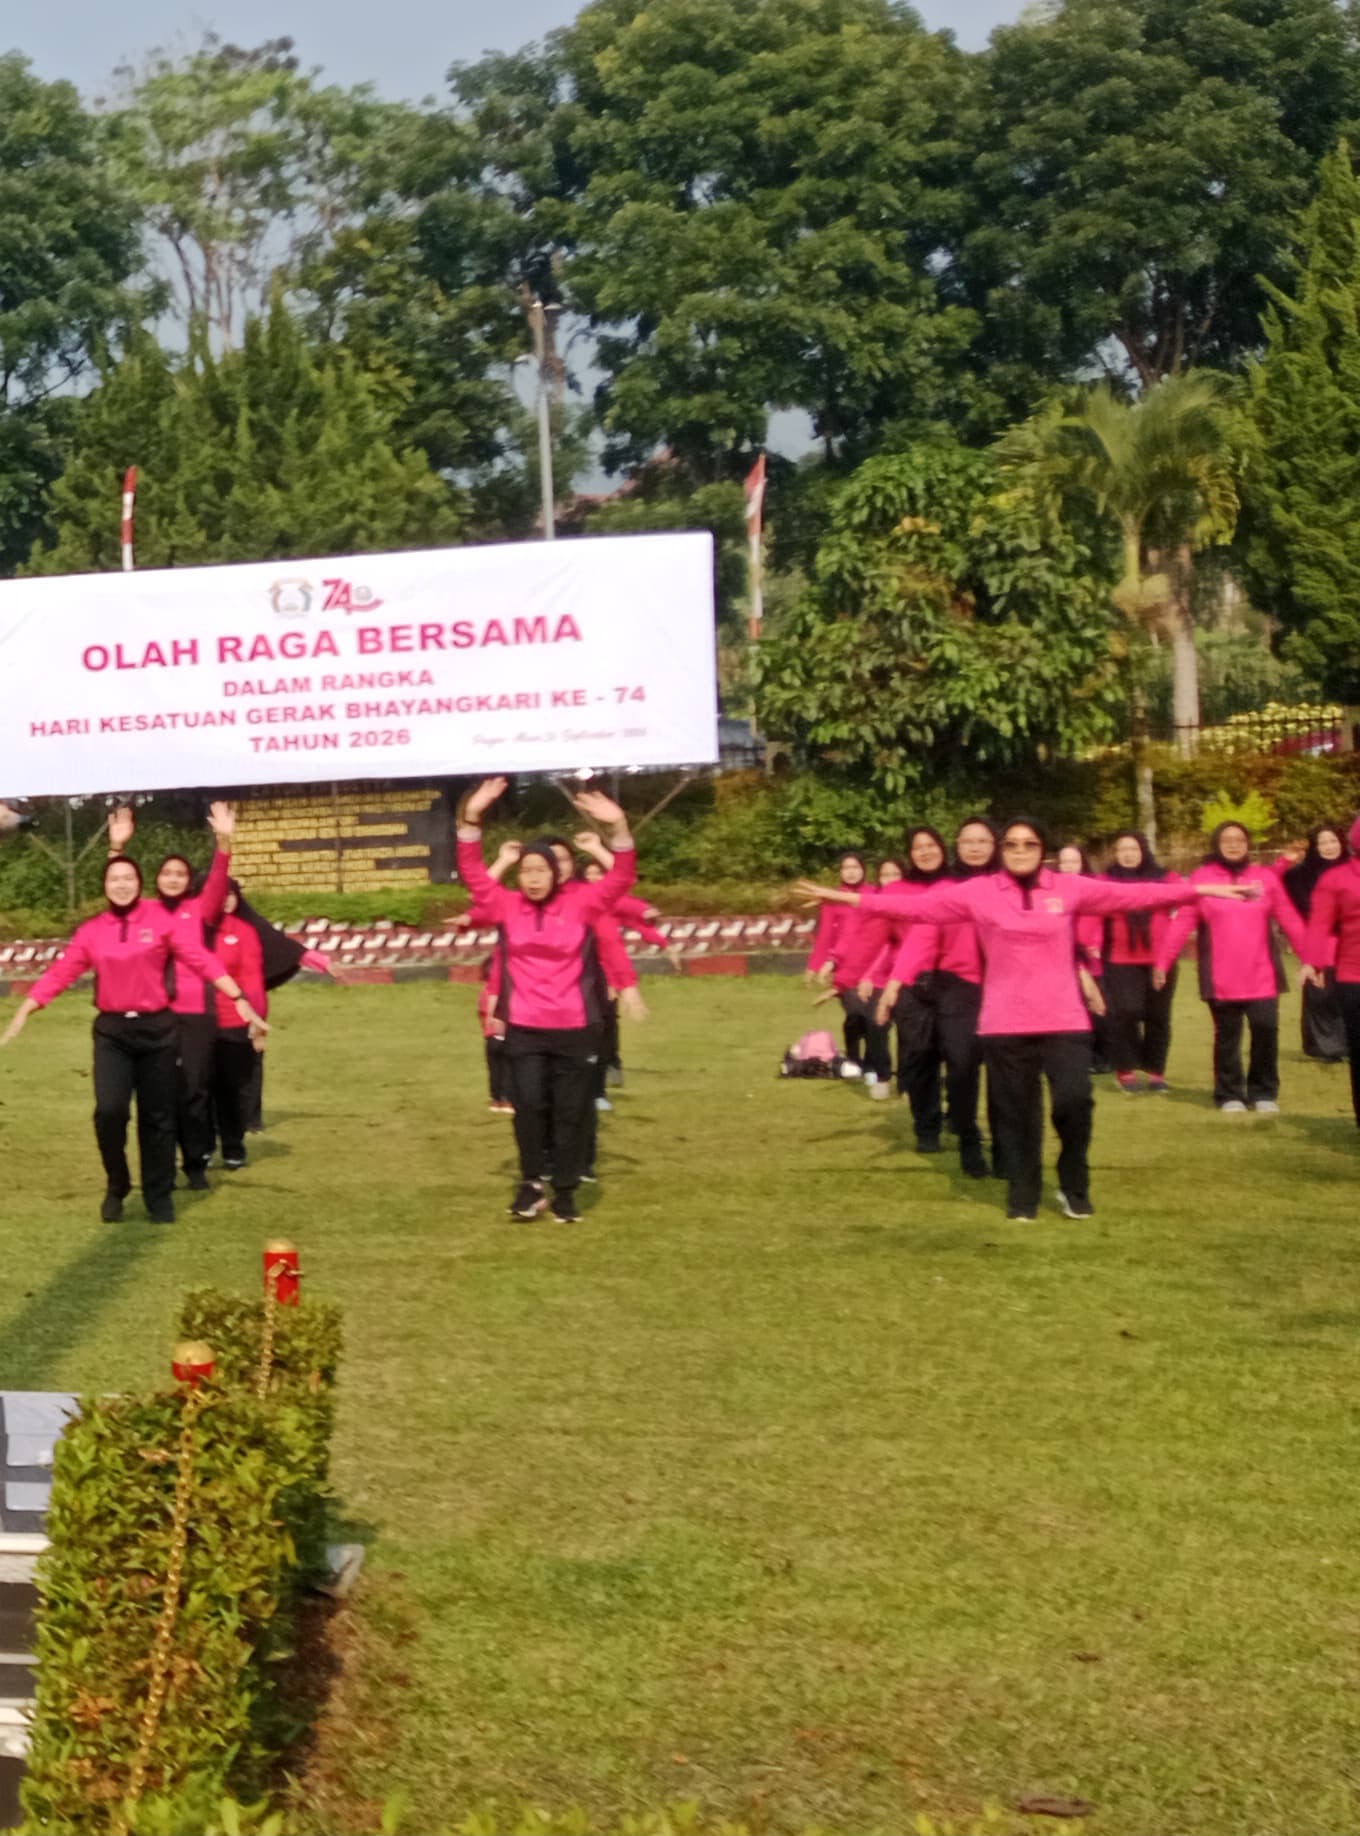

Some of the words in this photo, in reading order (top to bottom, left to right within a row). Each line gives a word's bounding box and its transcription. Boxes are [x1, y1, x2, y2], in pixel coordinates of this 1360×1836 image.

[81, 637, 201, 673] OLAH
[217, 630, 341, 664] RAGA
[355, 613, 584, 656] BERSAMA
[223, 675, 312, 697] DALAM
[320, 669, 435, 691] RANGKA
[29, 717, 90, 737] HARI
[99, 709, 237, 734] KESATUAN
[245, 703, 336, 725] GERAK
[345, 692, 541, 719] BHAYANGKARI
[550, 689, 587, 707] KE
[613, 685, 647, 703] 74
[250, 732, 340, 753] TAHUN
[349, 728, 411, 749] 2026
